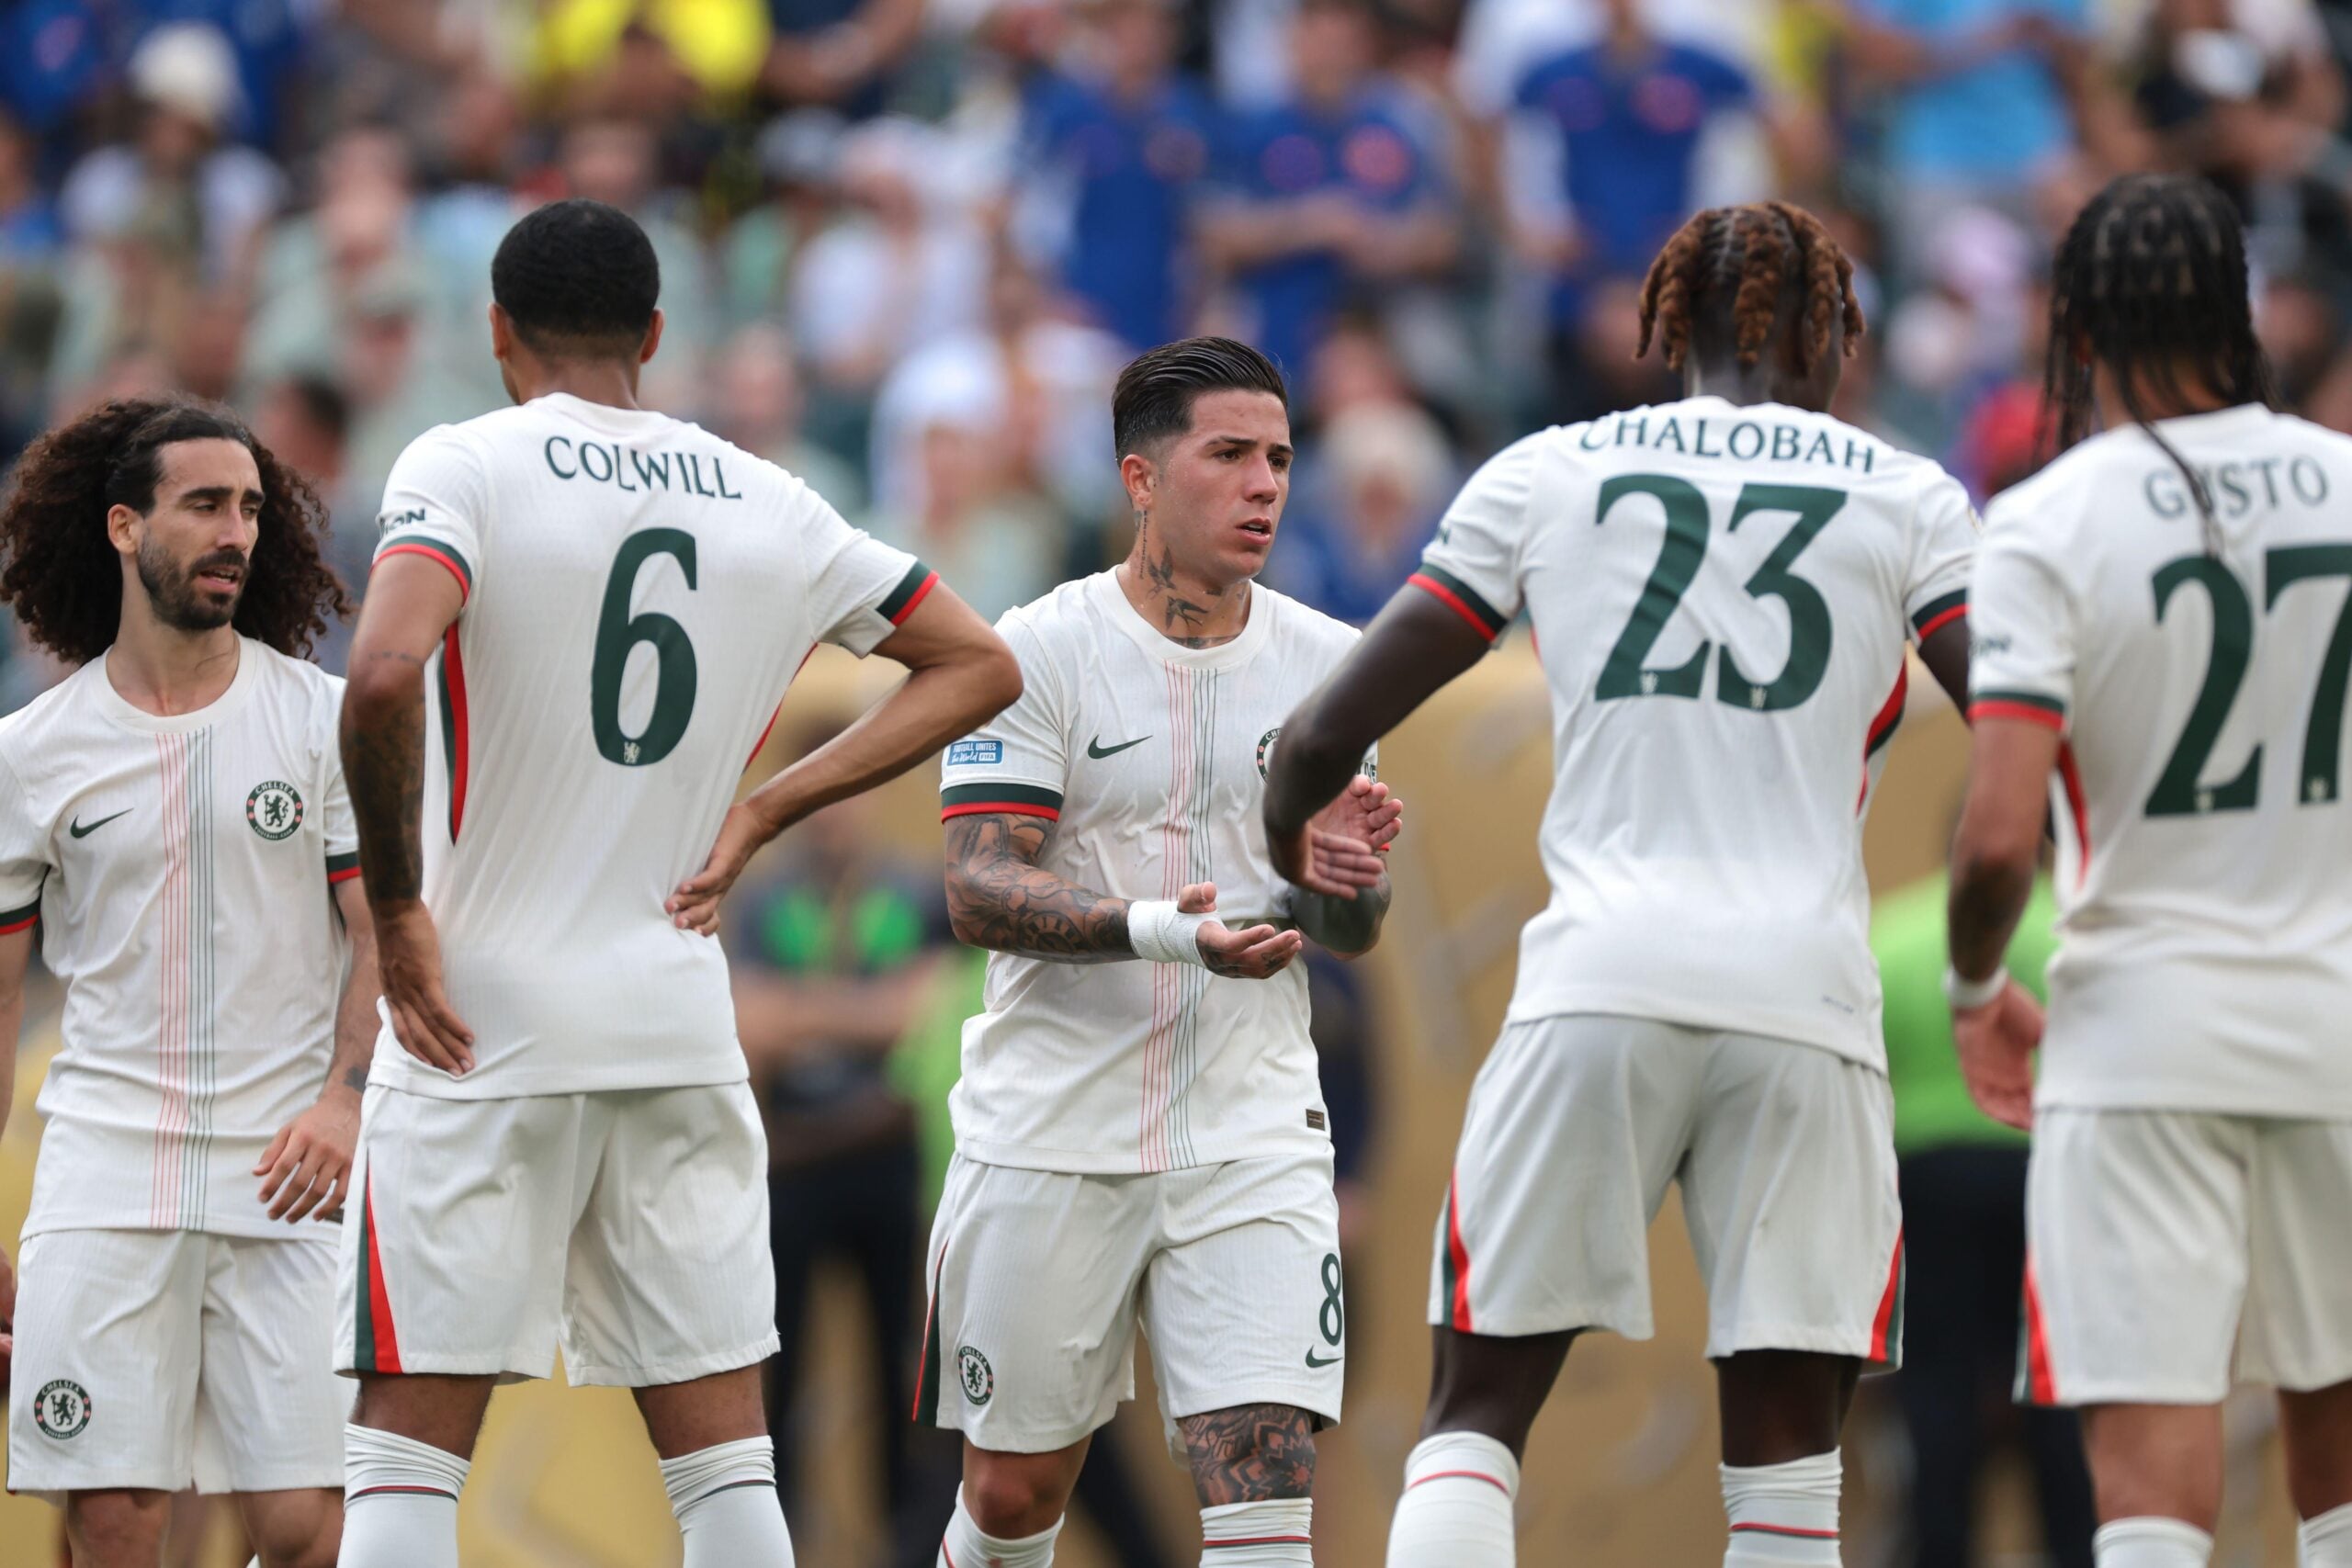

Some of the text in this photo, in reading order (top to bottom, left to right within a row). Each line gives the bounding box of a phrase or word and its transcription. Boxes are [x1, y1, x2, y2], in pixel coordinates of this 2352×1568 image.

[544, 445, 742, 500] COLWILL
[1580, 416, 1875, 474] CHALOBAH
[1594, 473, 1849, 713] 23
[591, 526, 696, 766] 6
[2143, 542, 2352, 819] 27
[975, 741, 997, 752] UNITES
[255, 781, 294, 797] CHELSEA
[1318, 1253, 1343, 1347] 8
[961, 1348, 989, 1369] CHELSEA
[41, 1380, 81, 1396] CHELSEA
